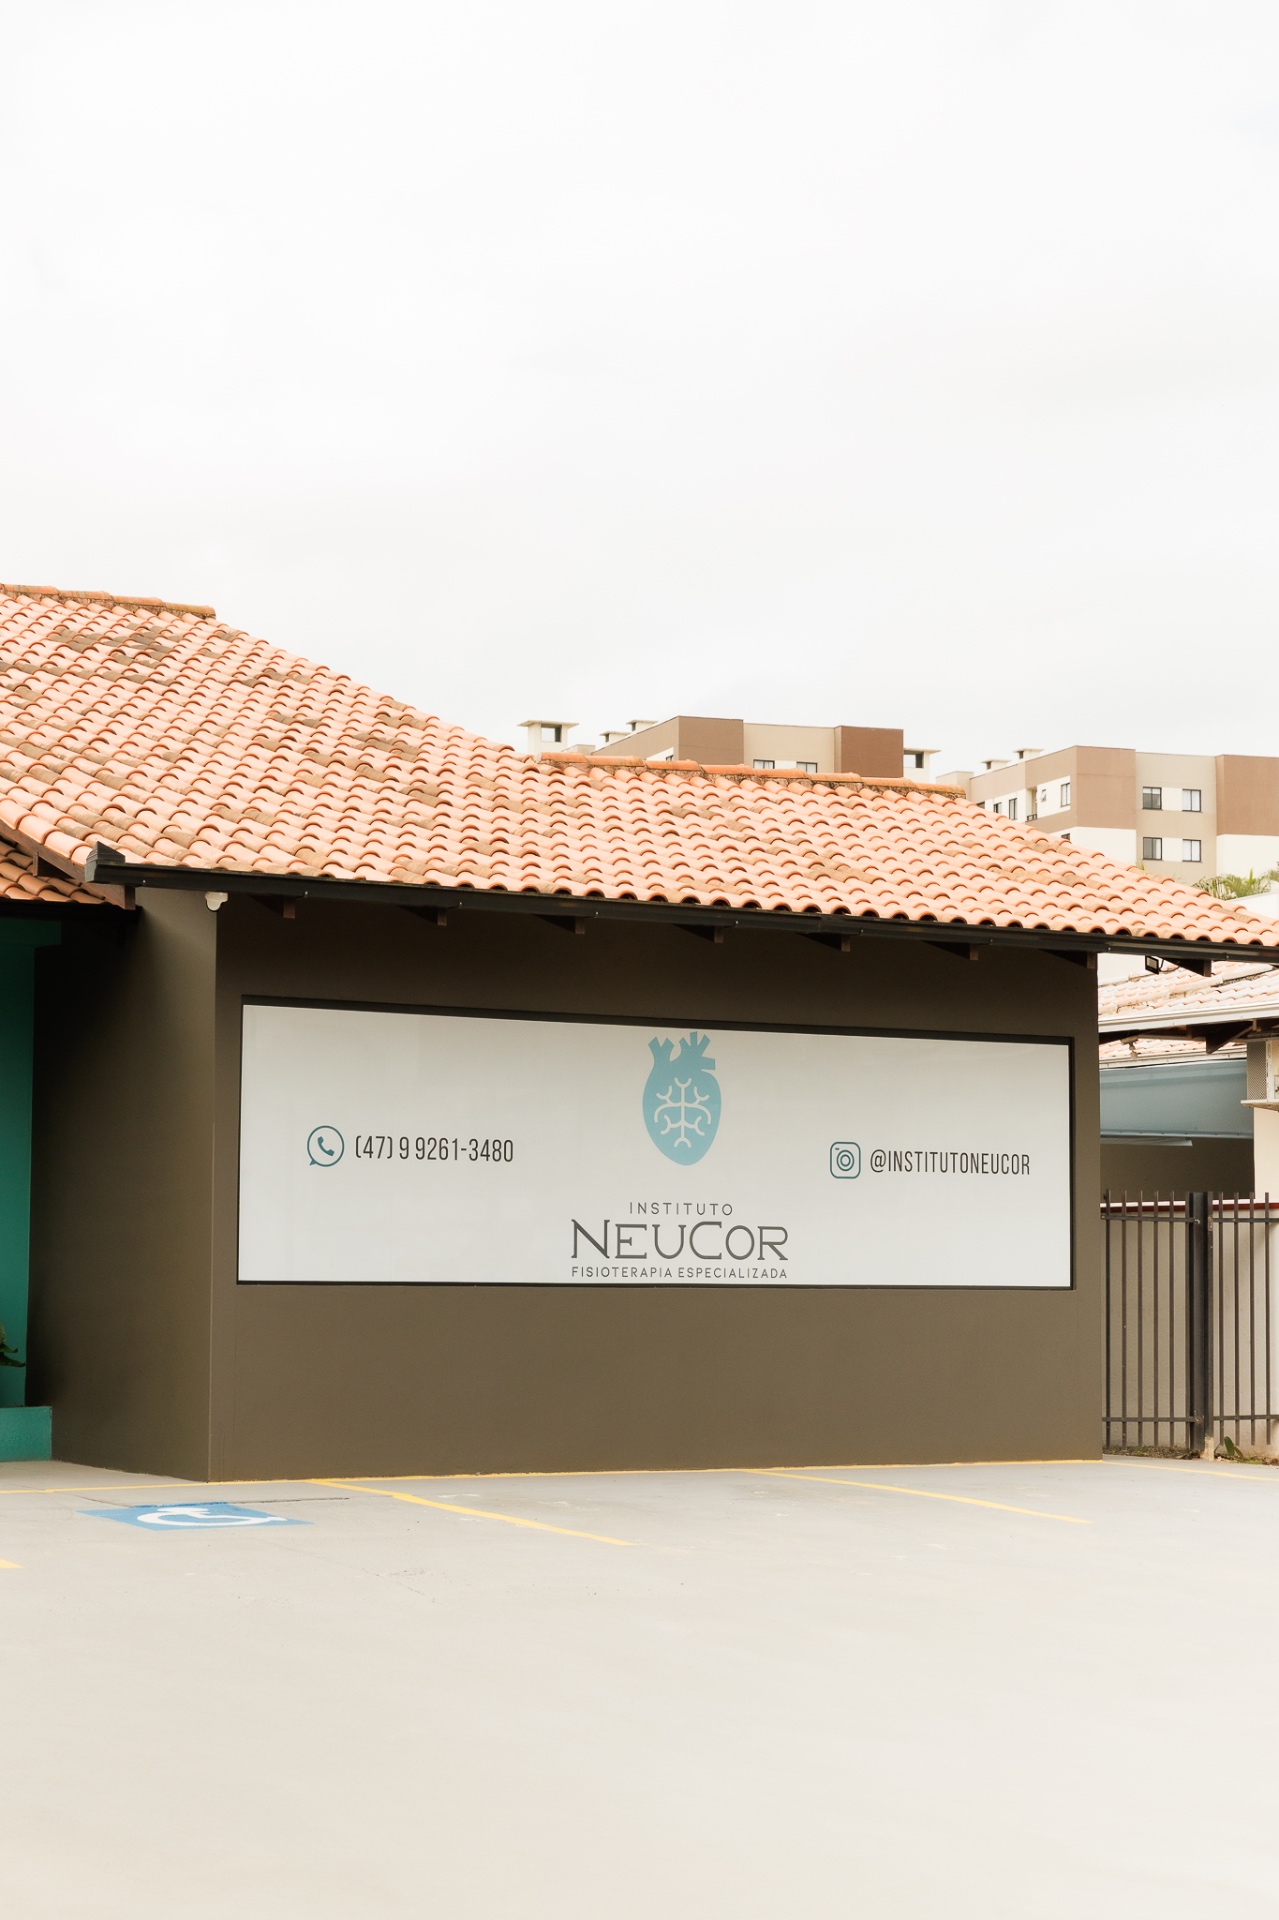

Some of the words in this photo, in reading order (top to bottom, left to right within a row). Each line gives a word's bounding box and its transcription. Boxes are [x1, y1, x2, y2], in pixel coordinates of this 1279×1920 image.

[355, 1135, 393, 1160] (47)
[399, 1136, 410, 1160] 9
[415, 1136, 514, 1163] 9261-3480
[870, 1148, 1031, 1176] @INSTITUTONEUCOR
[629, 1201, 733, 1216] INSTITUTO
[571, 1266, 673, 1278] FISIOTERAPIA
[678, 1267, 787, 1279] ESPECIALIZADA
